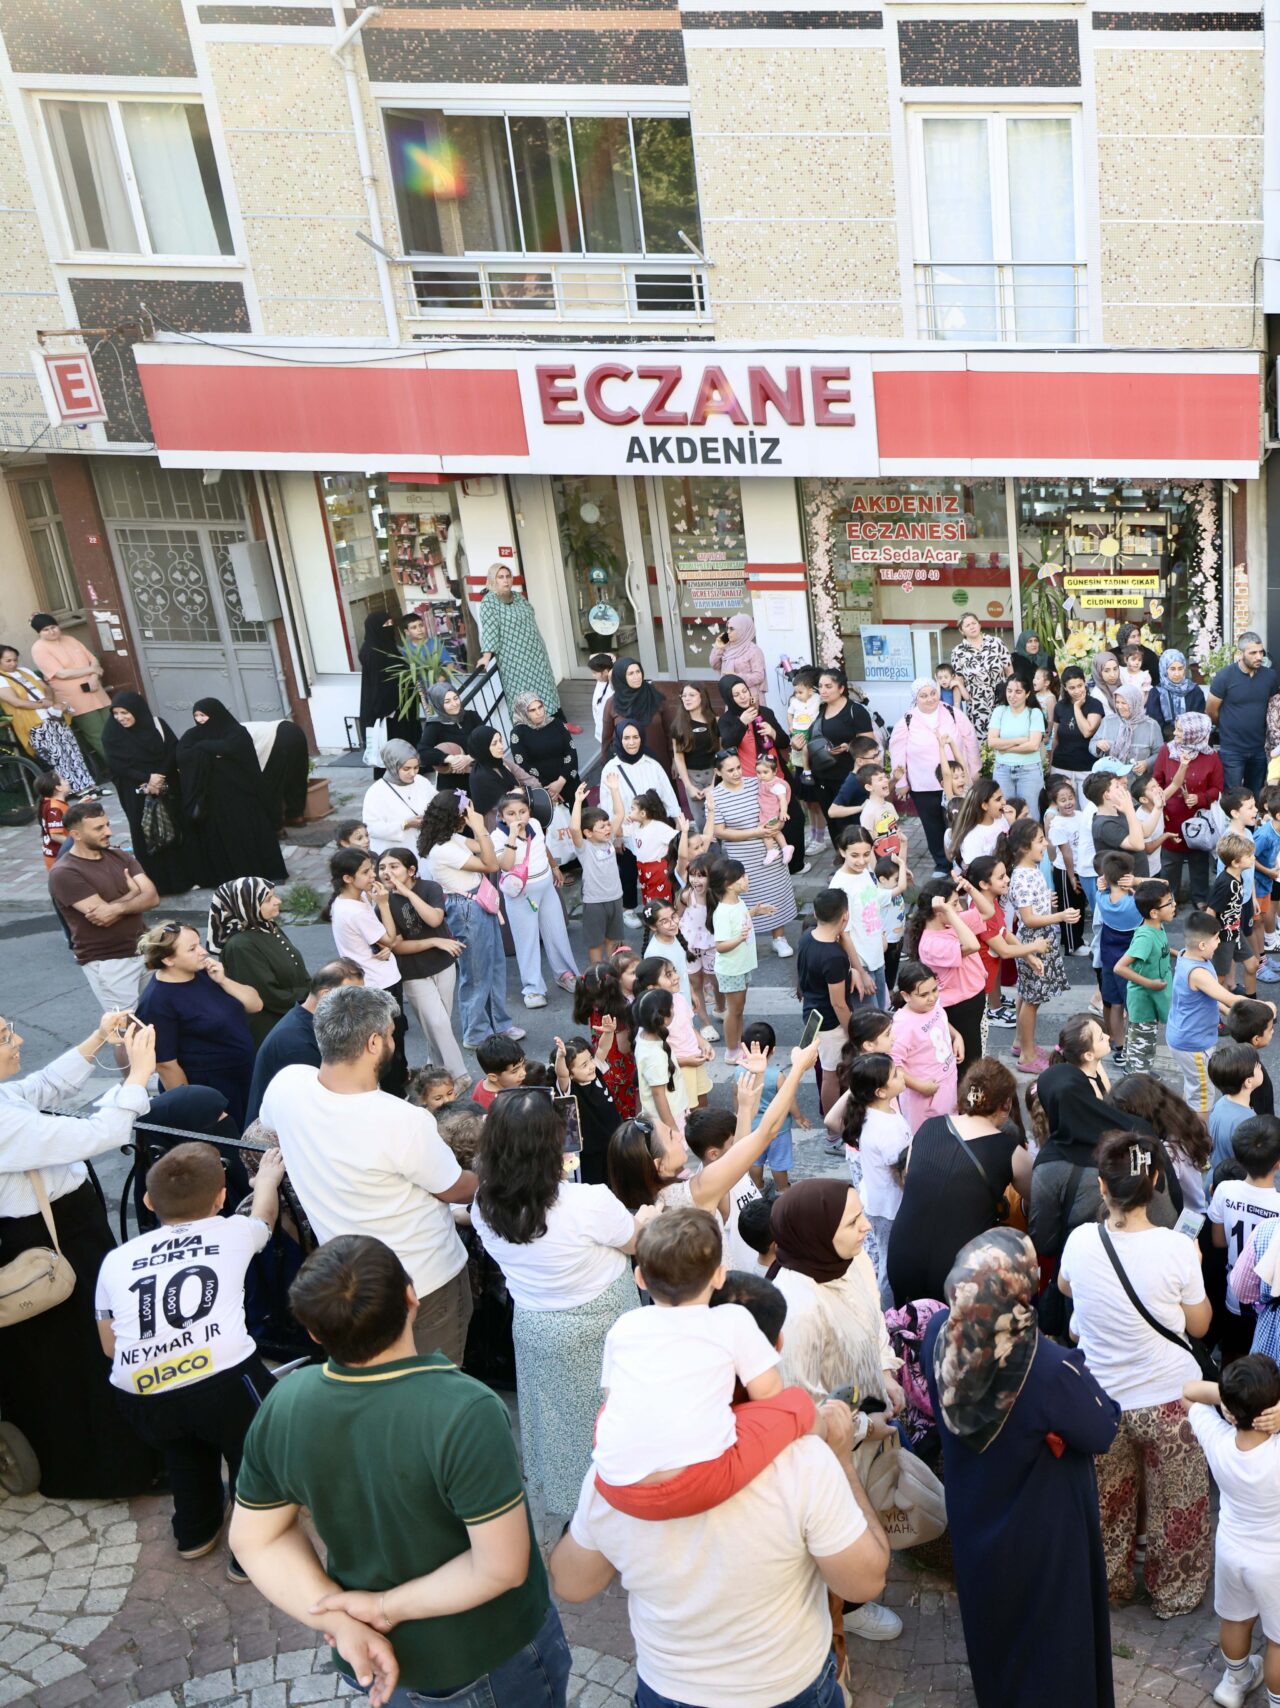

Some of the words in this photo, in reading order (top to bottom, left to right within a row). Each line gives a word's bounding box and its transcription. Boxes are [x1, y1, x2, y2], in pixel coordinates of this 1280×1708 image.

[53, 363, 93, 410] E
[534, 362, 856, 427] ECZANE
[625, 430, 782, 465] AKDENİZ
[852, 492, 960, 513] AKDENİZ
[846, 520, 967, 540] ECZANESİ
[924, 547, 960, 562] Acar
[915, 570, 927, 580] 00
[927, 570, 940, 580] 40
[131, 1244, 221, 1271] SORTE
[151, 1234, 203, 1254] VIVA
[128, 1264, 219, 1341] 10
[120, 1331, 194, 1367] NEYMAR
[205, 1322, 221, 1343] JR
[136, 1354, 209, 1393] placo
